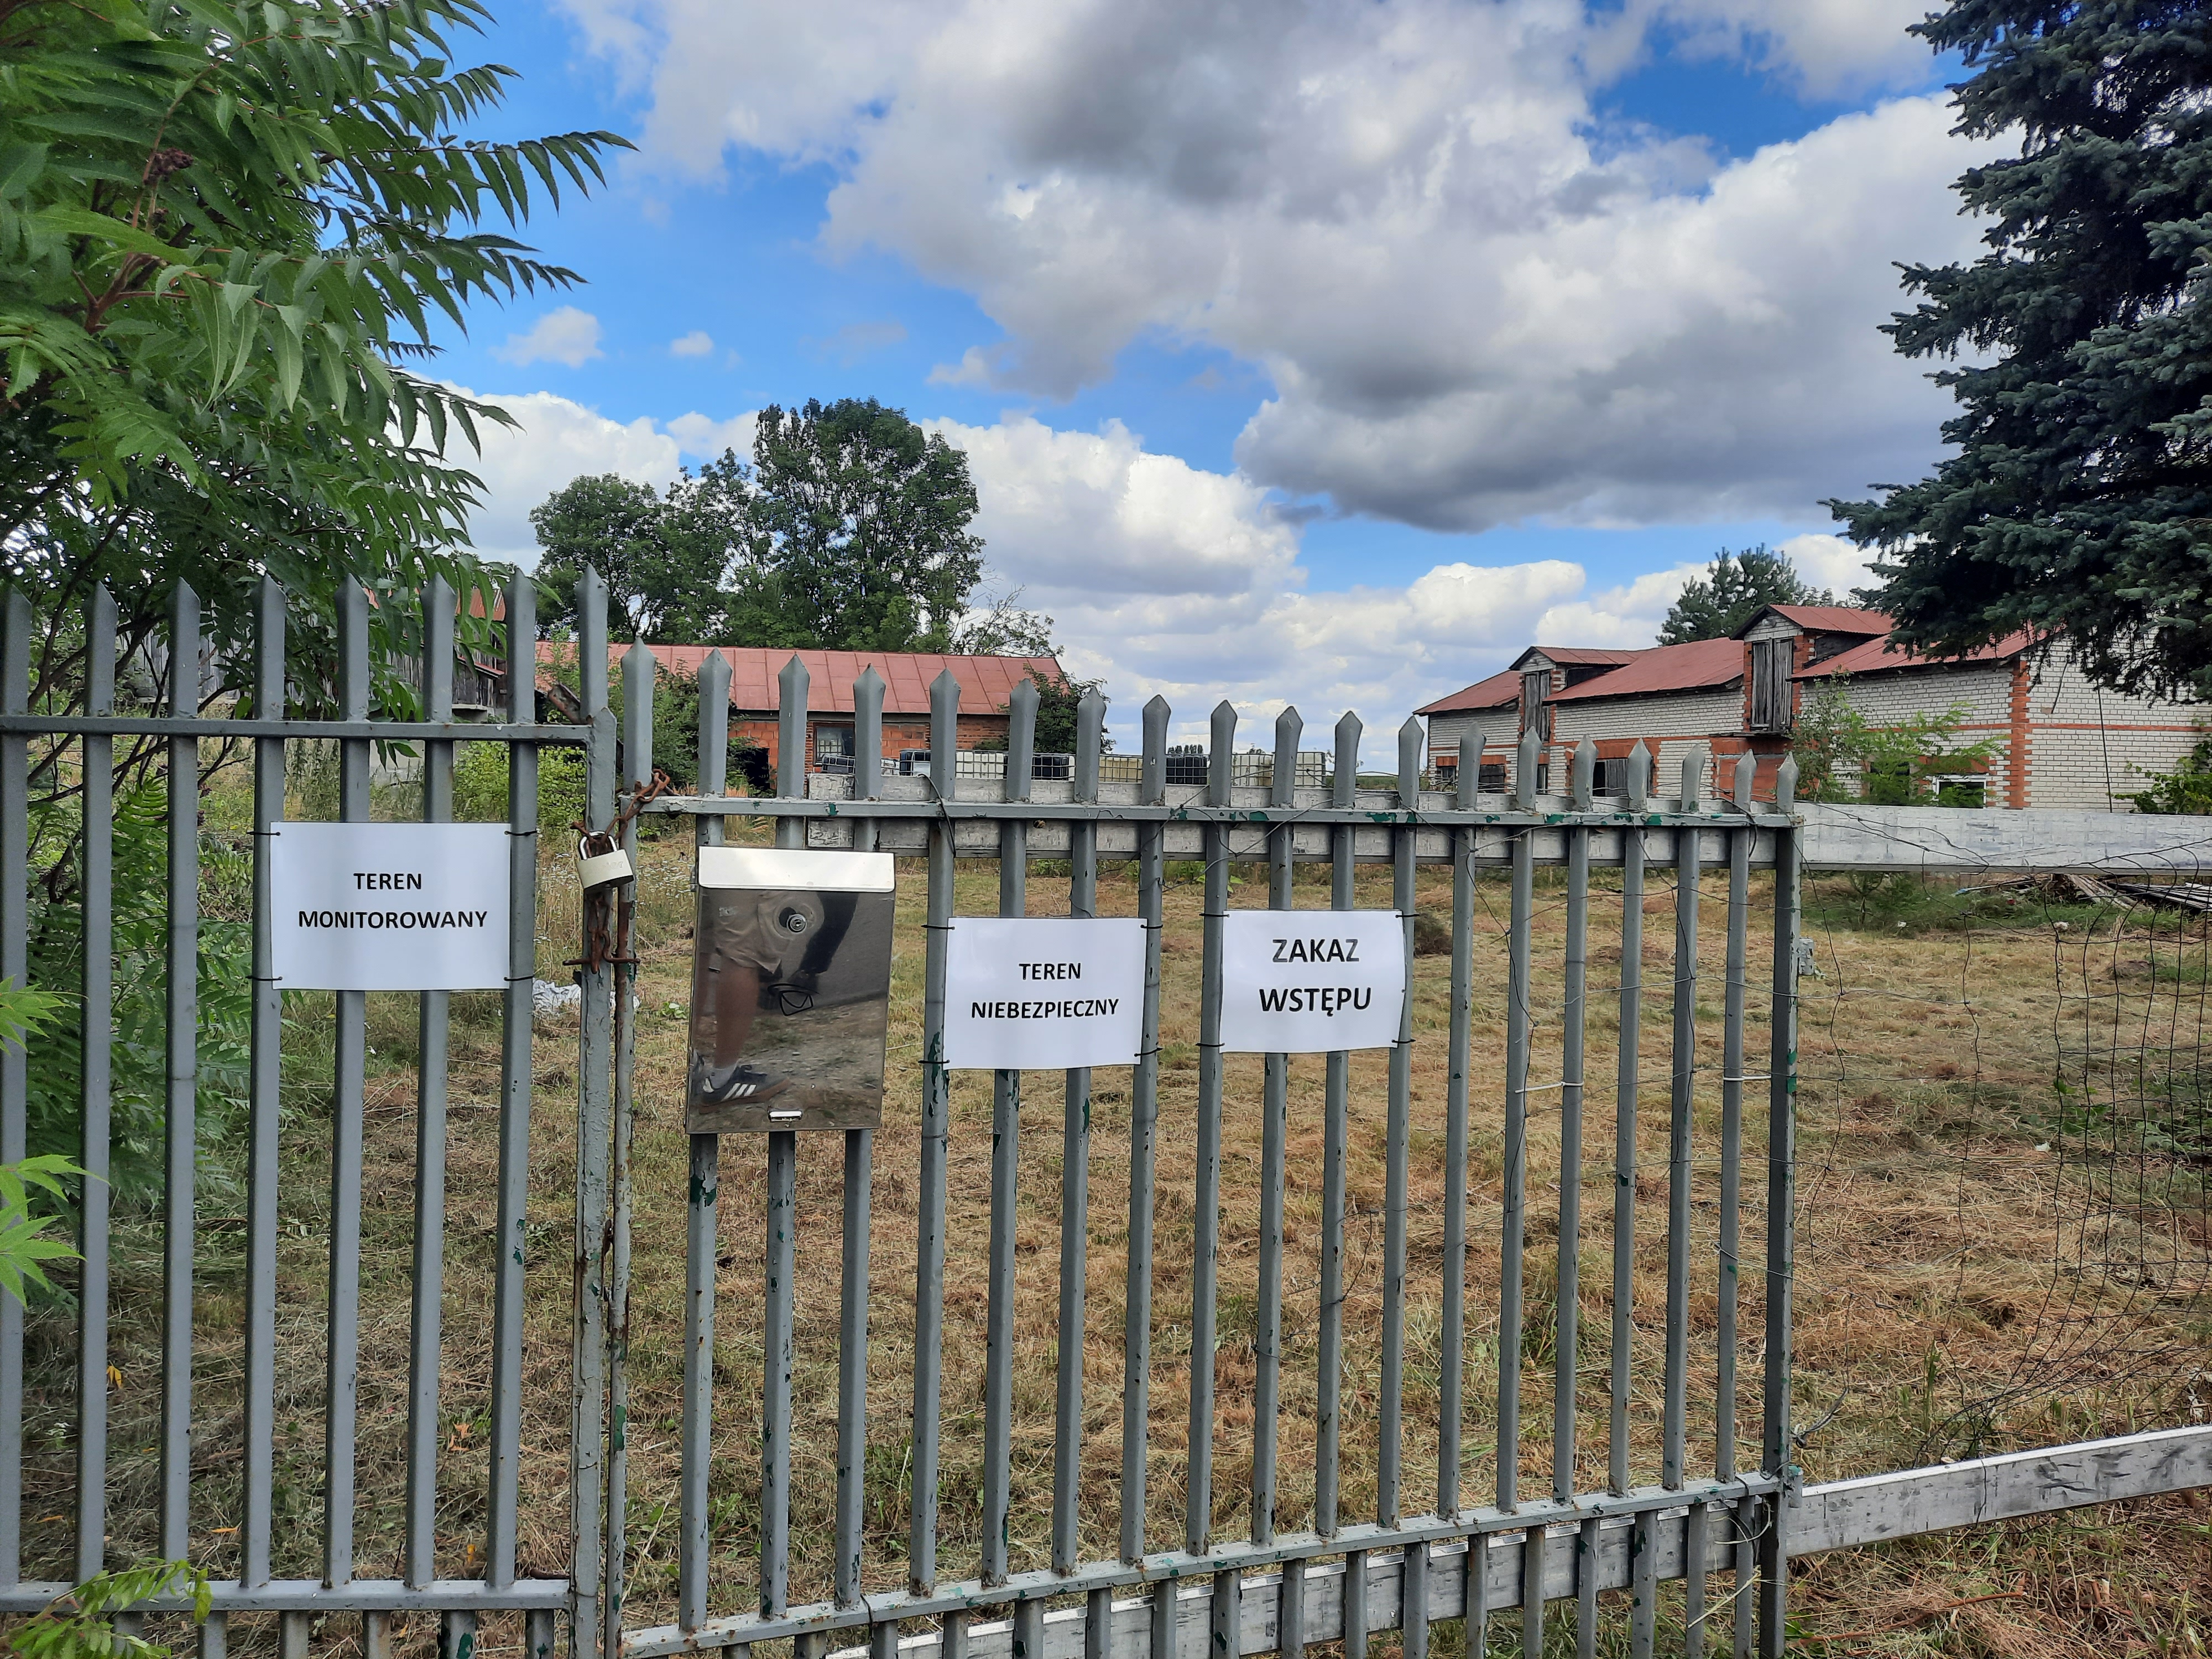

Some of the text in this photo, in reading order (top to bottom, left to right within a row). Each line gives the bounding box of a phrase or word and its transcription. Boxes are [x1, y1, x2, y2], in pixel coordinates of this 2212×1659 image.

[353, 873, 421, 890] TEREN
[299, 911, 488, 929] MONITOROWANY
[1272, 938, 1360, 963] ZAKAZ
[1019, 962, 1081, 980] TEREN
[971, 998, 1119, 1019] NIEBEZPIECZNY
[1259, 987, 1372, 1017] WSTĘPU
